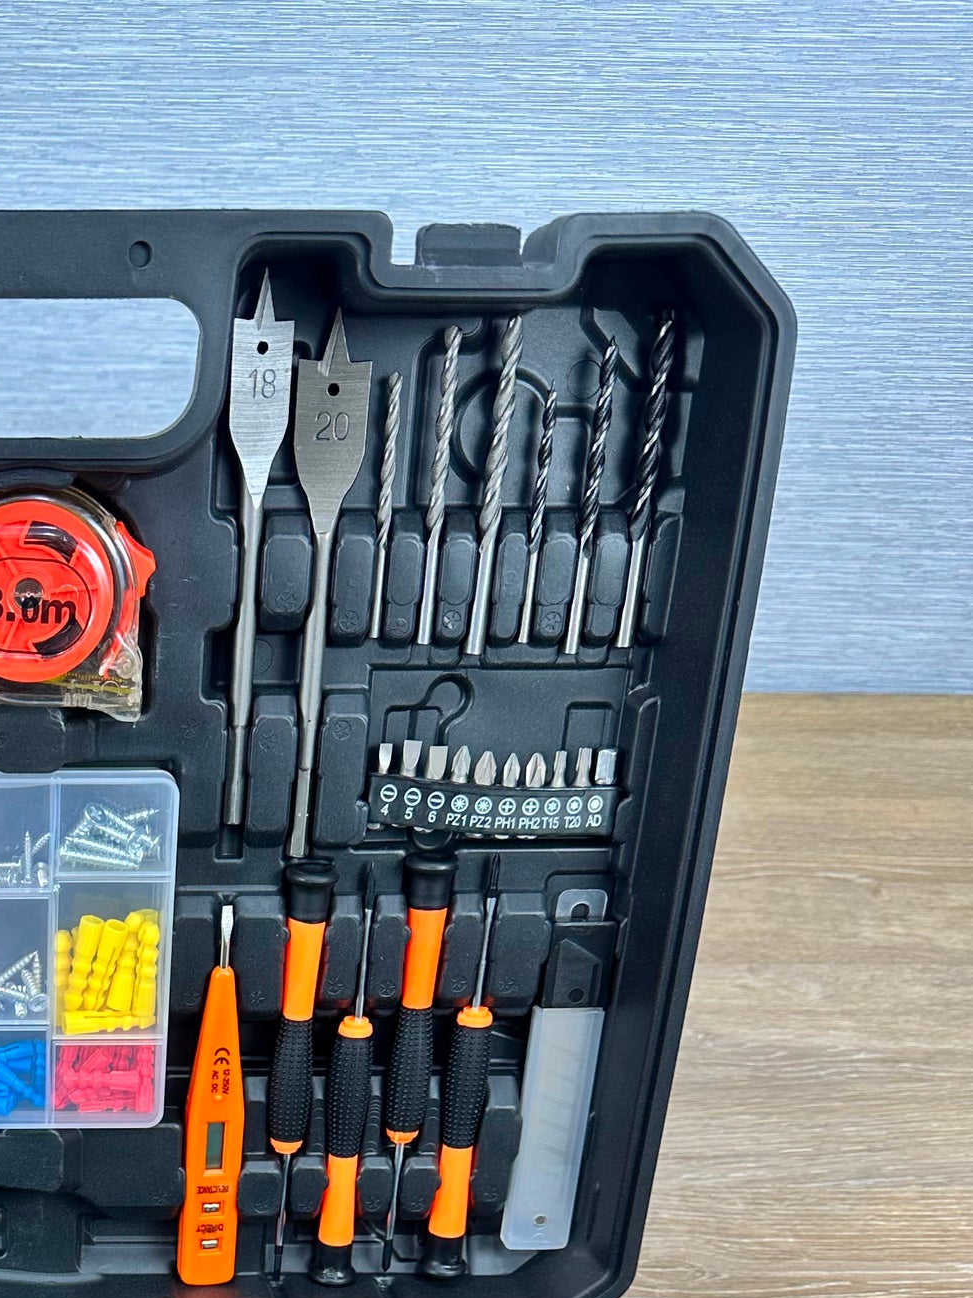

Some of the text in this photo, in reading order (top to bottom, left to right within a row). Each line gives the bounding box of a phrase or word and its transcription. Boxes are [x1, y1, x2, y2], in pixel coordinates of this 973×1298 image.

[249, 368, 277, 399] 18
[314, 411, 350, 441] 20
[380, 804, 389, 816] 4
[404, 808, 413, 820] 5
[427, 811, 437, 823] 6
[445, 814, 467, 827] PZ1
[469, 815, 492, 829] PZ2
[494, 815, 516, 829] PH1
[518, 816, 540, 830] PH2
[542, 816, 560, 829] T15
[564, 815, 581, 828] T20
[586, 815, 602, 827] AD
[213, 1047, 230, 1065] CE
